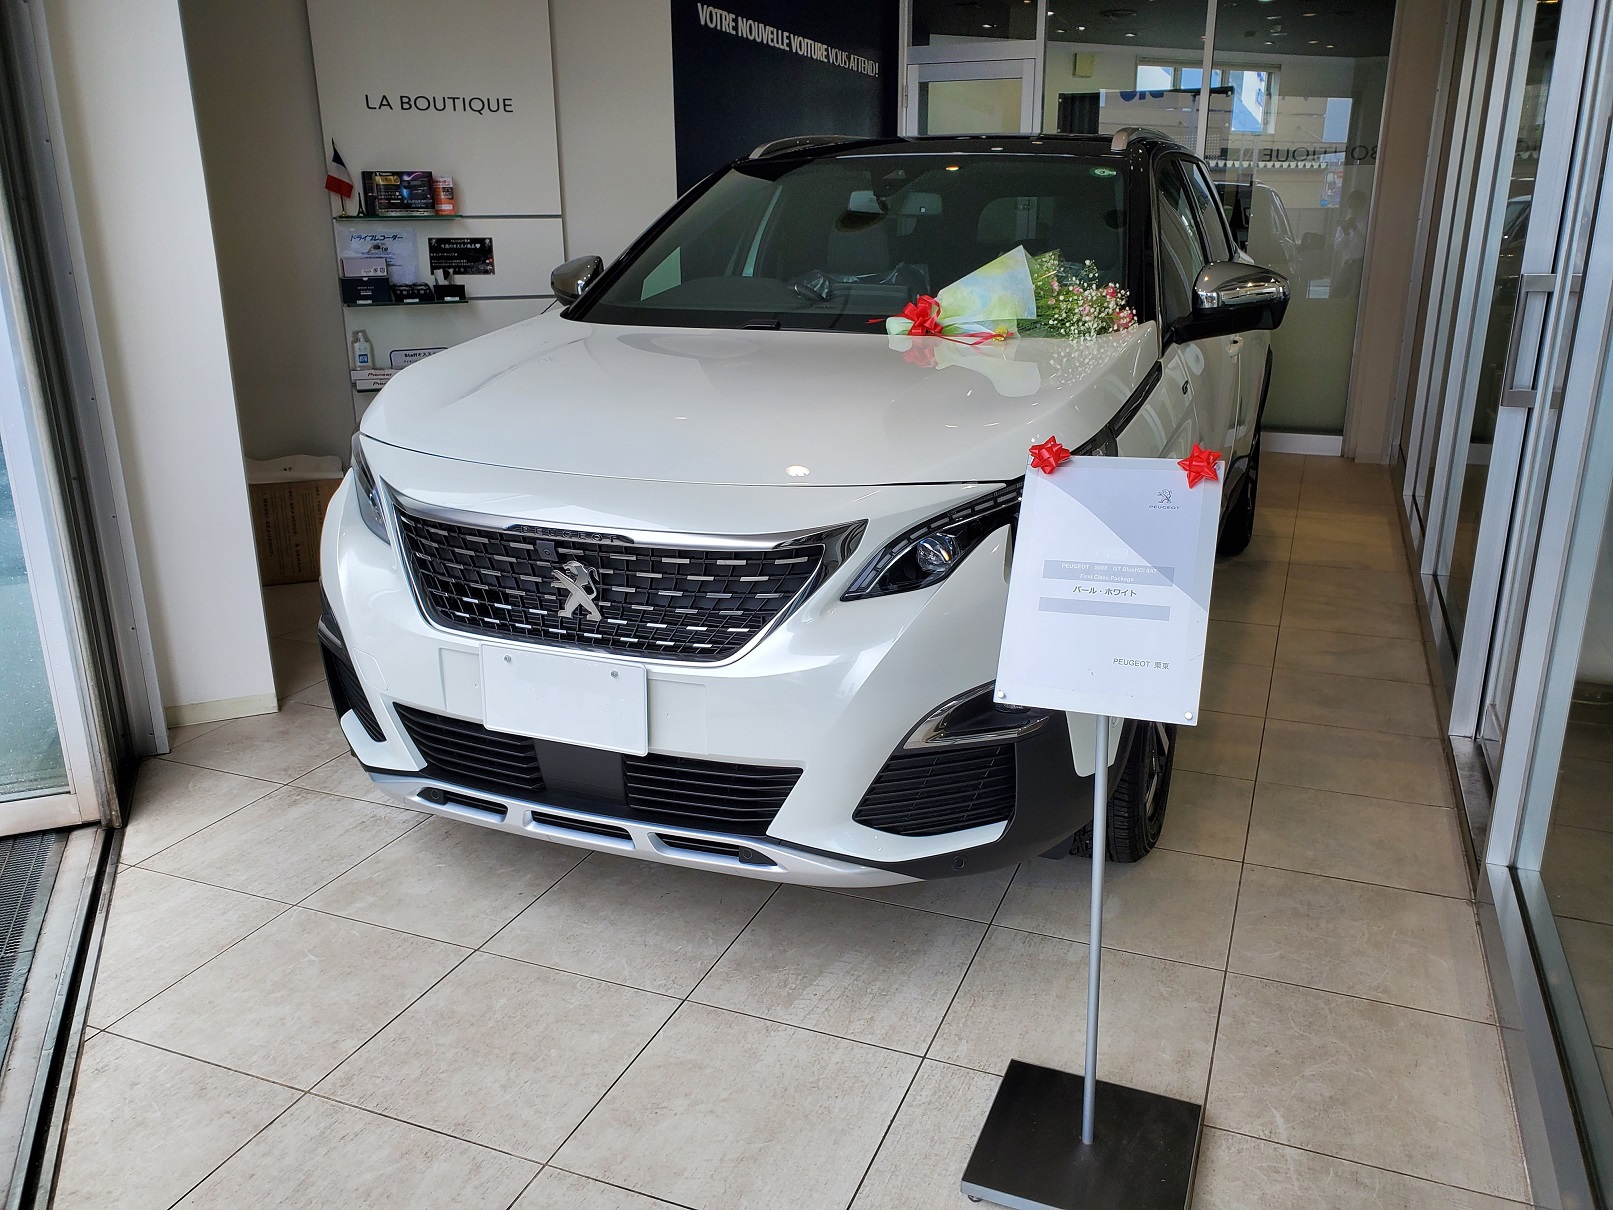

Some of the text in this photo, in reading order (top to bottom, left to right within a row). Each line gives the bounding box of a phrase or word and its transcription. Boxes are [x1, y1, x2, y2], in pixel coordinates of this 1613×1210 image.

[697, 3, 736, 35] VOTRE
[738, 16, 790, 51] NOUVELLE
[790, 33, 828, 63] VOITURE
[828, 47, 849, 69] VOUS
[365, 94, 514, 115] LA BOUTIQUE
[520, 526, 617, 542] PEUGEOT
[1061, 562, 1090, 570] PEUGEOT
[1110, 575, 1135, 583] Package
[1113, 658, 1150, 668] PEUGEOT
